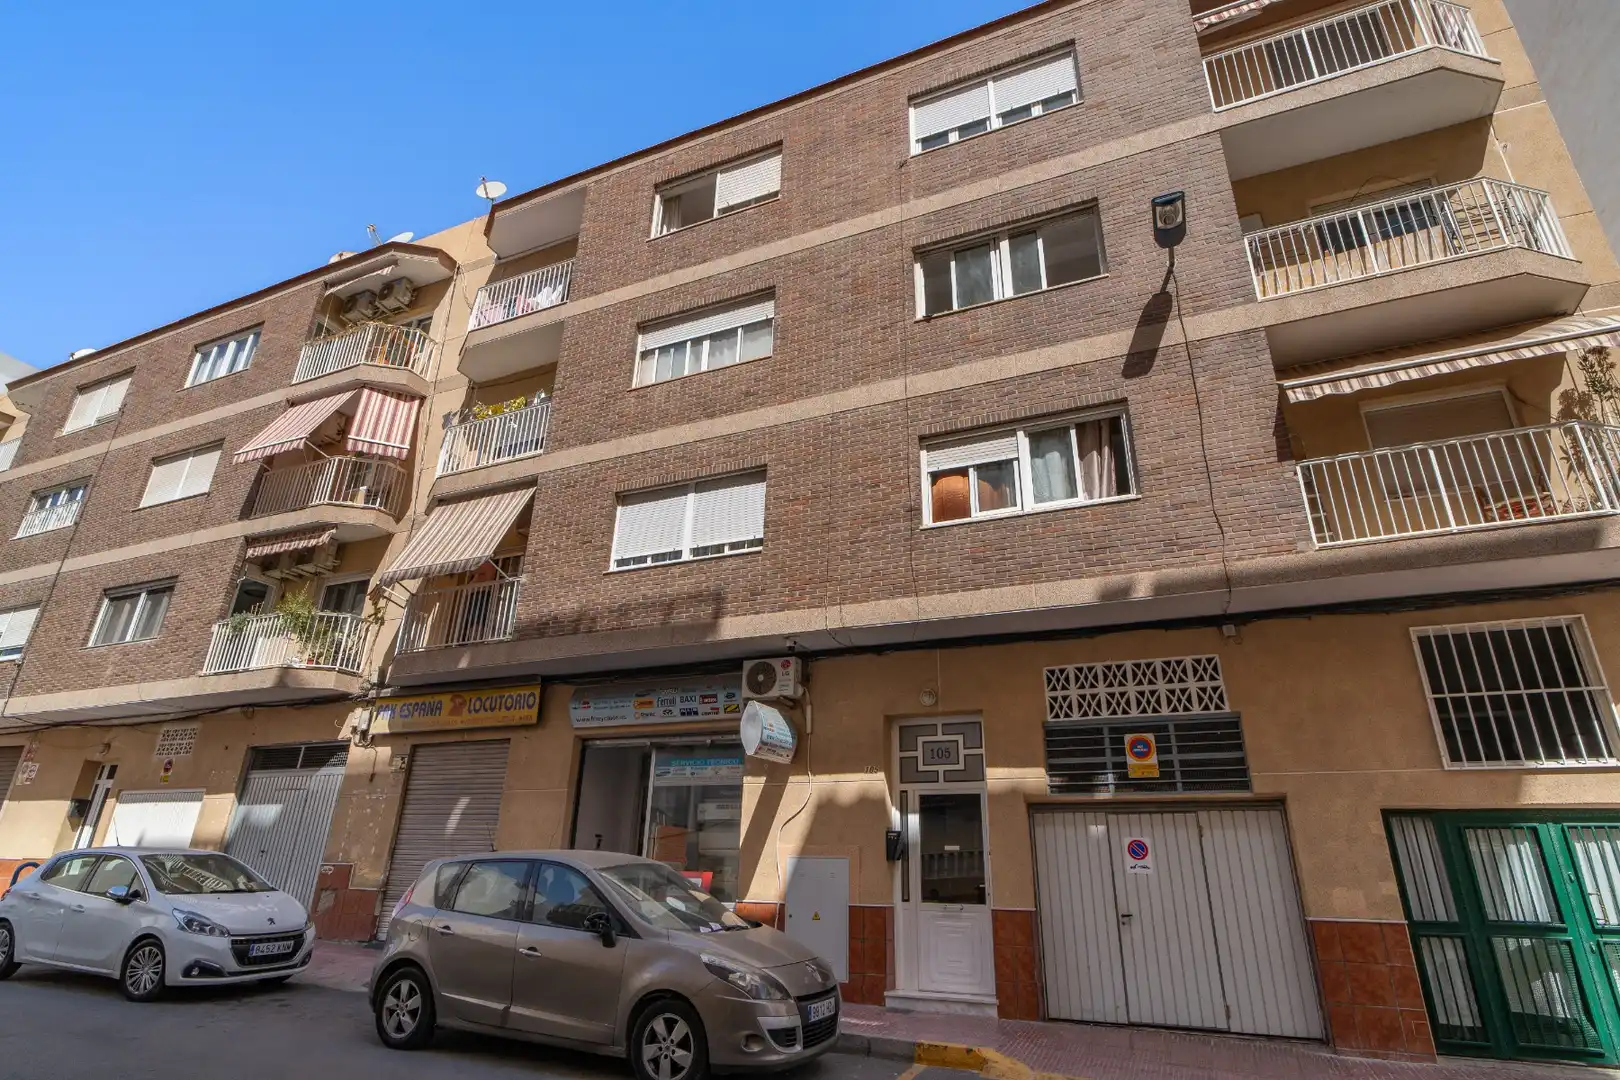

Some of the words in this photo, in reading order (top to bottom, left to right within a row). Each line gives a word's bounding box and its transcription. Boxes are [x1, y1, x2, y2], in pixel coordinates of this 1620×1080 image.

[467, 691, 537, 714] LOCUTORIO
[680, 695, 697, 704] BAXI
[929, 747, 951, 760] 105
[671, 758, 705, 767] SERVICIO
[864, 766, 879, 775] 105
